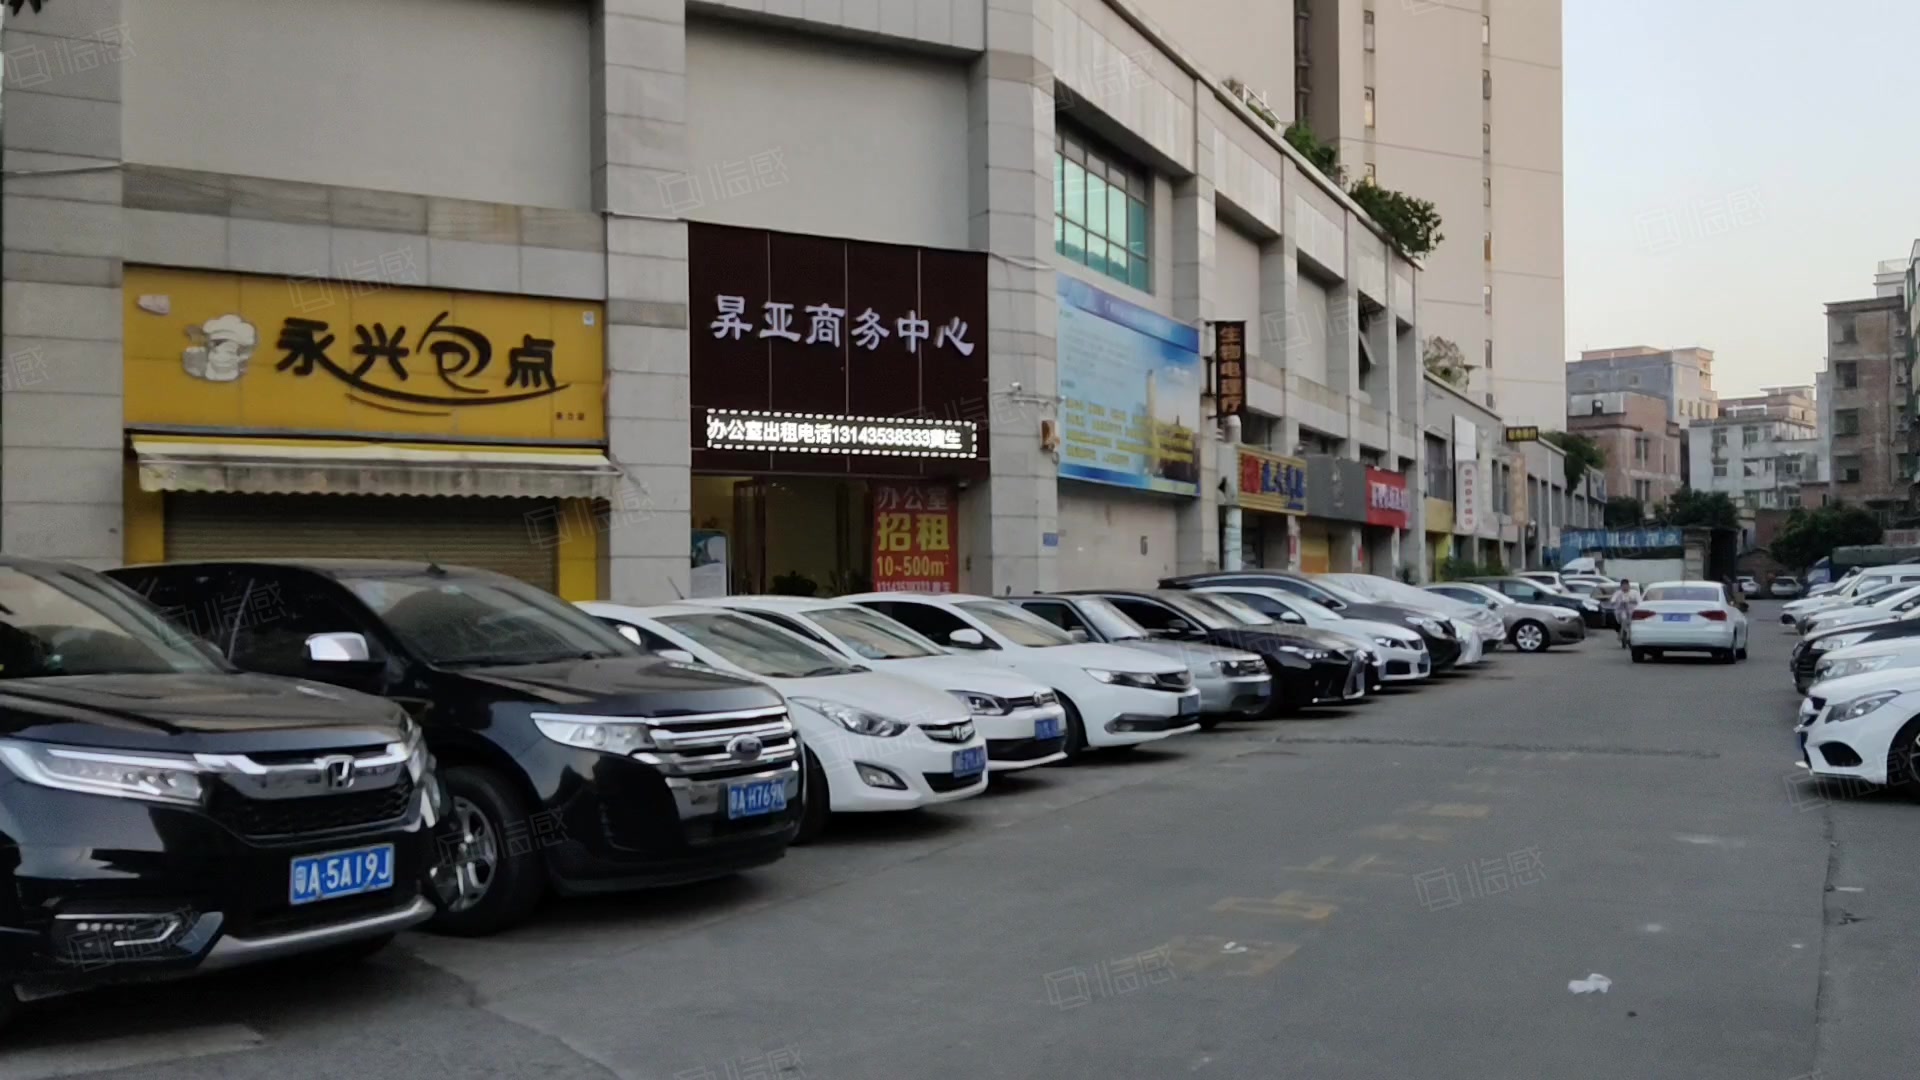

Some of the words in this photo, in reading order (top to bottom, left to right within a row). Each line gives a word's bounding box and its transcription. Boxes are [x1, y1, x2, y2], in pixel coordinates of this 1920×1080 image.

[710, 294, 974, 356] 昇亚商务中心
[276, 311, 568, 405] 永兴包点
[878, 486, 948, 511] 办公室
[877, 513, 950, 551] 招租
